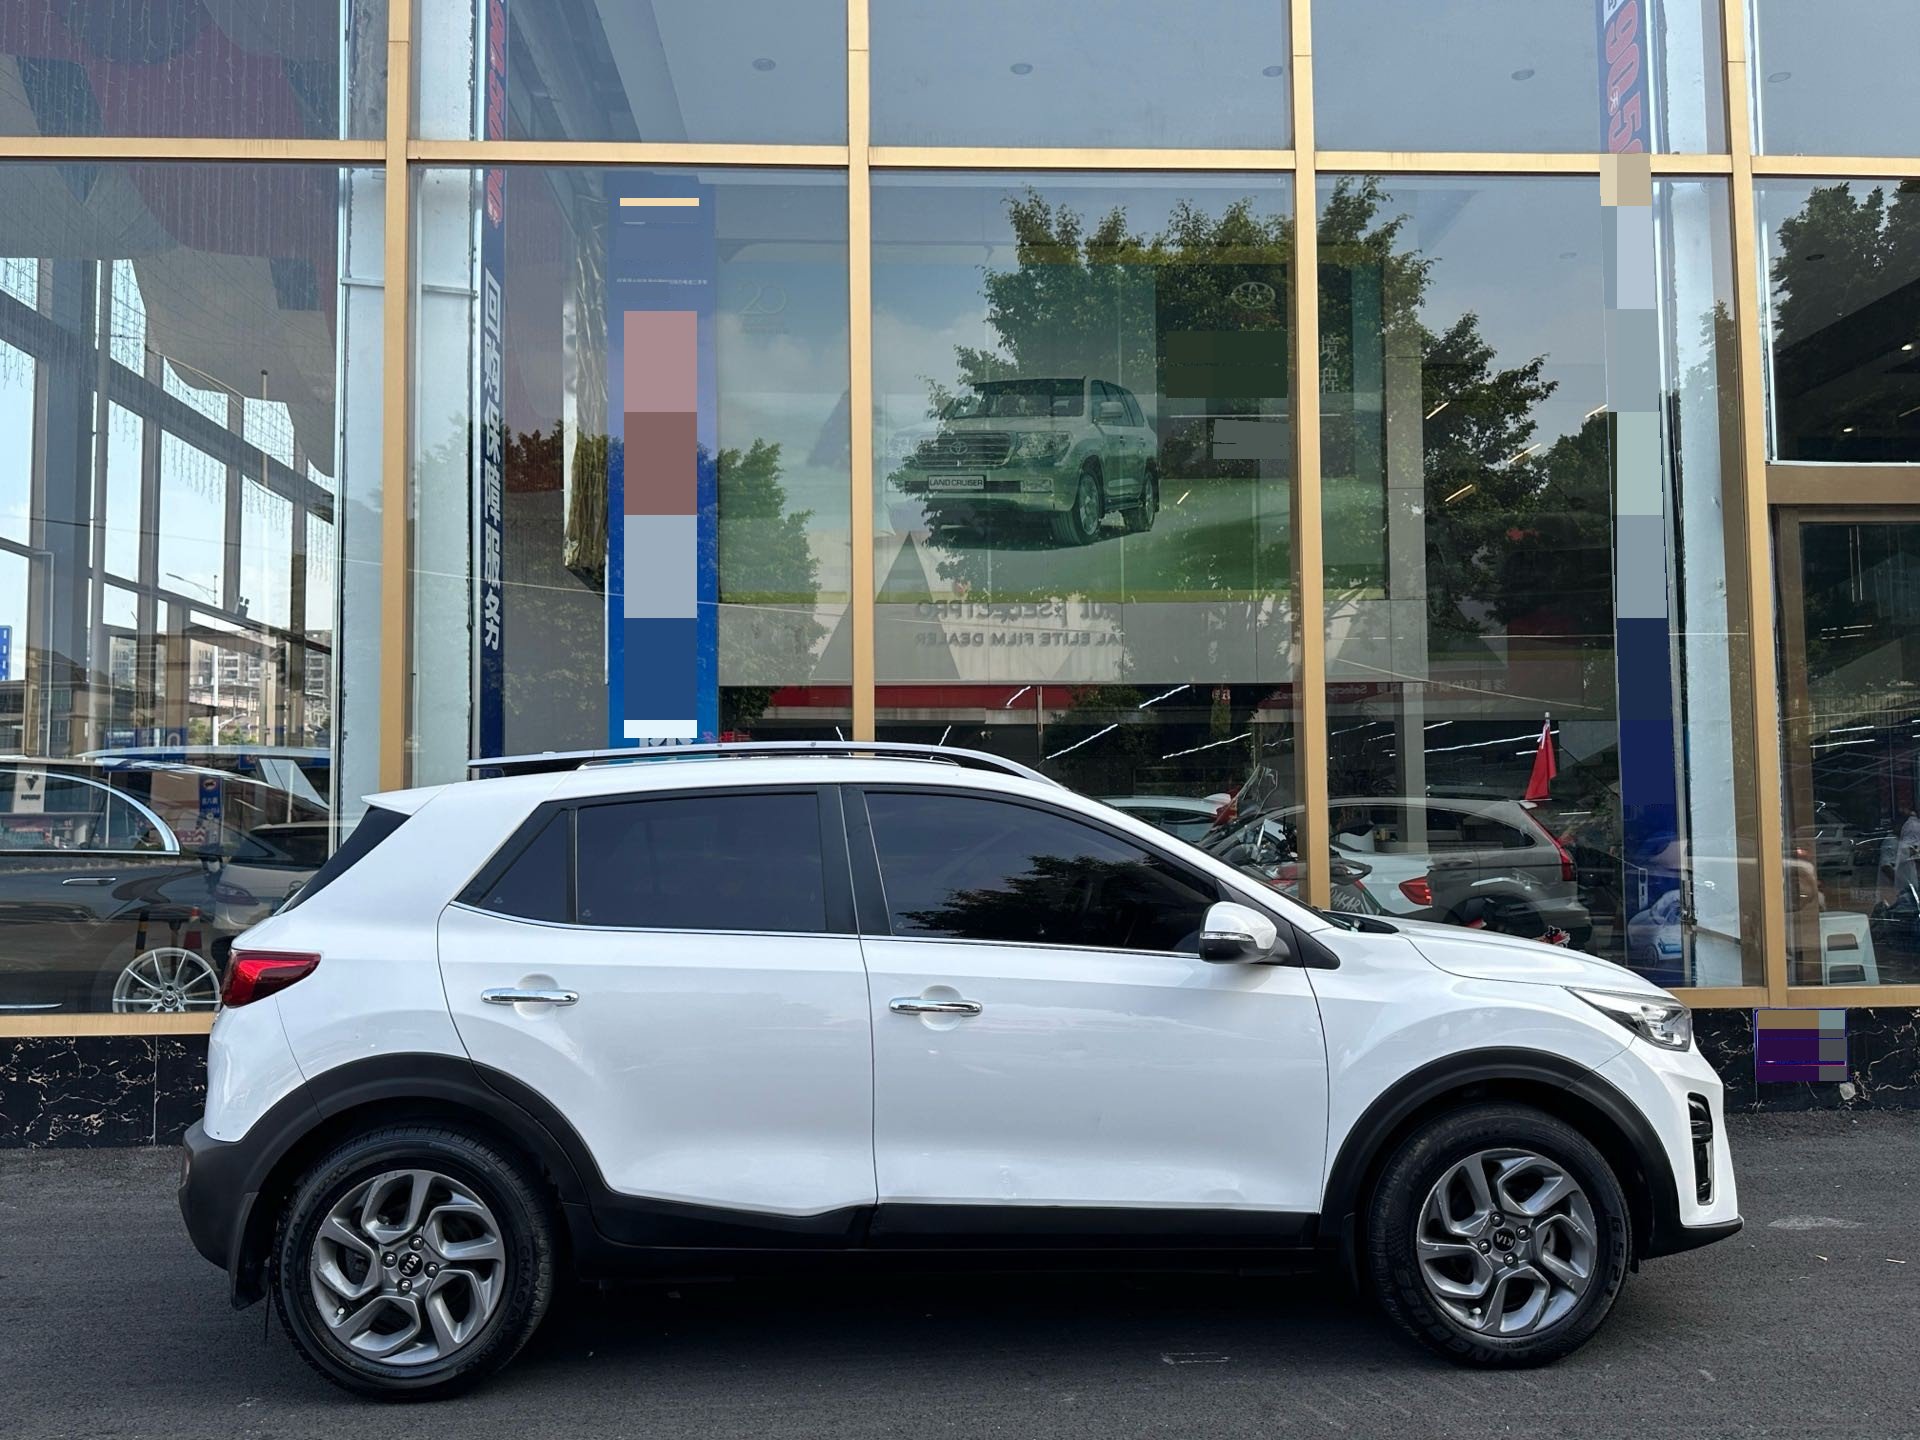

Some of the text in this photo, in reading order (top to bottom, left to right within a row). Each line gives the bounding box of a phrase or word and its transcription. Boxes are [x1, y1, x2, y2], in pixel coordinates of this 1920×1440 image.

[484, 267, 501, 651] 回购保障服务
[929, 479, 984, 487] LAND CRUISER
[1496, 1233, 1514, 1246] KIA
[402, 1254, 420, 1274] KIA
